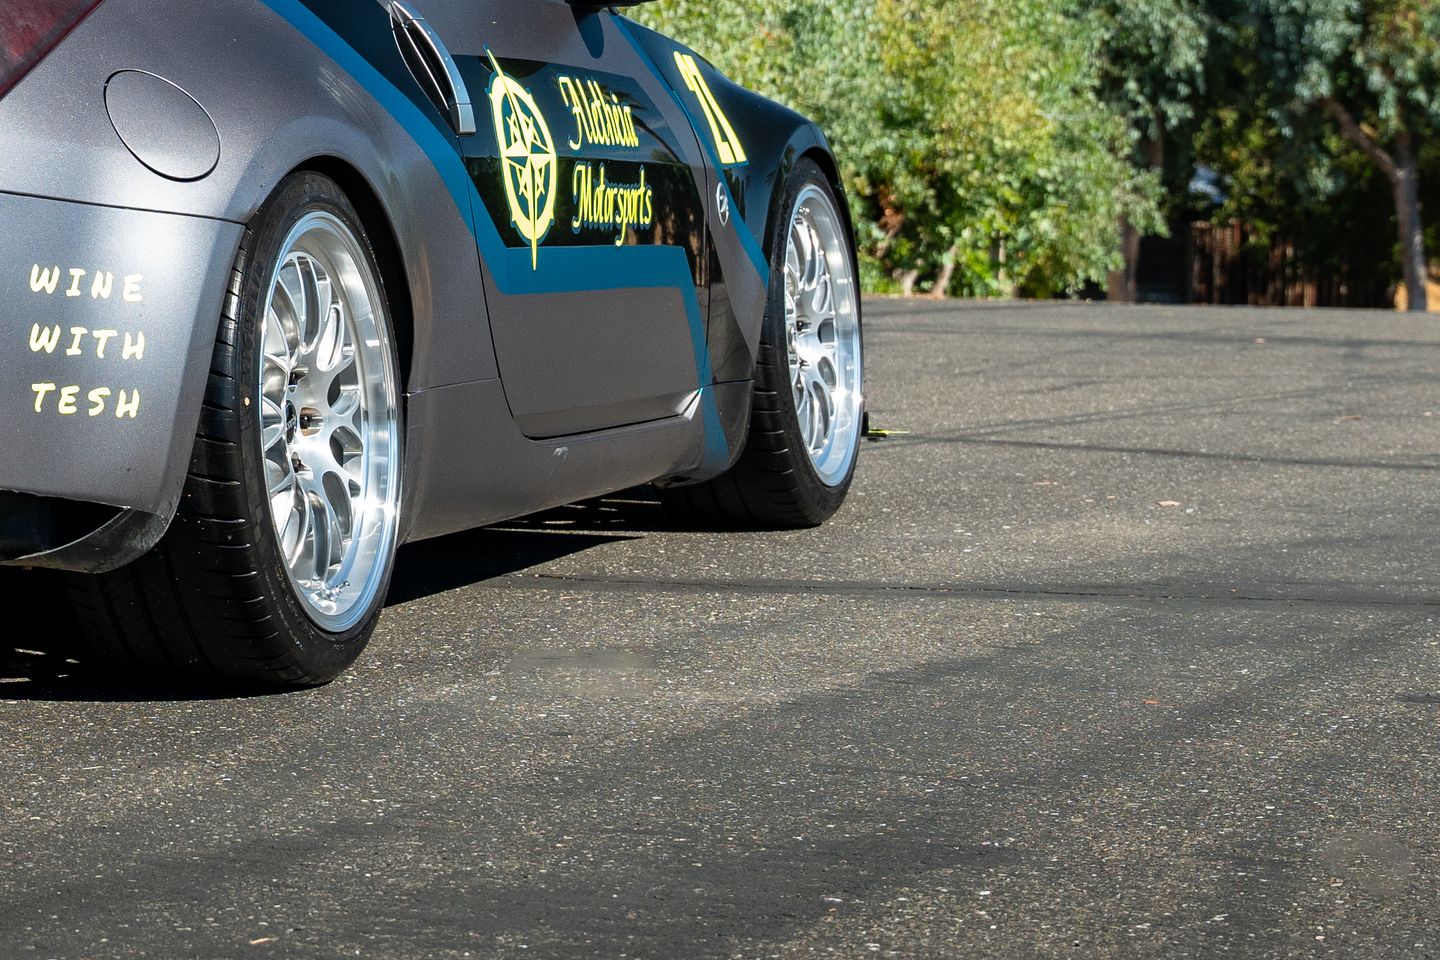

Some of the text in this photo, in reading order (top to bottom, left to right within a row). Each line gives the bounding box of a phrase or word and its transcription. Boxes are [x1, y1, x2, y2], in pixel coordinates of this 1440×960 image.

[572, 164, 652, 246] Motorsports
[29, 263, 144, 302] WINE
[29, 322, 146, 361] WITH
[31, 382, 141, 419] TESH
